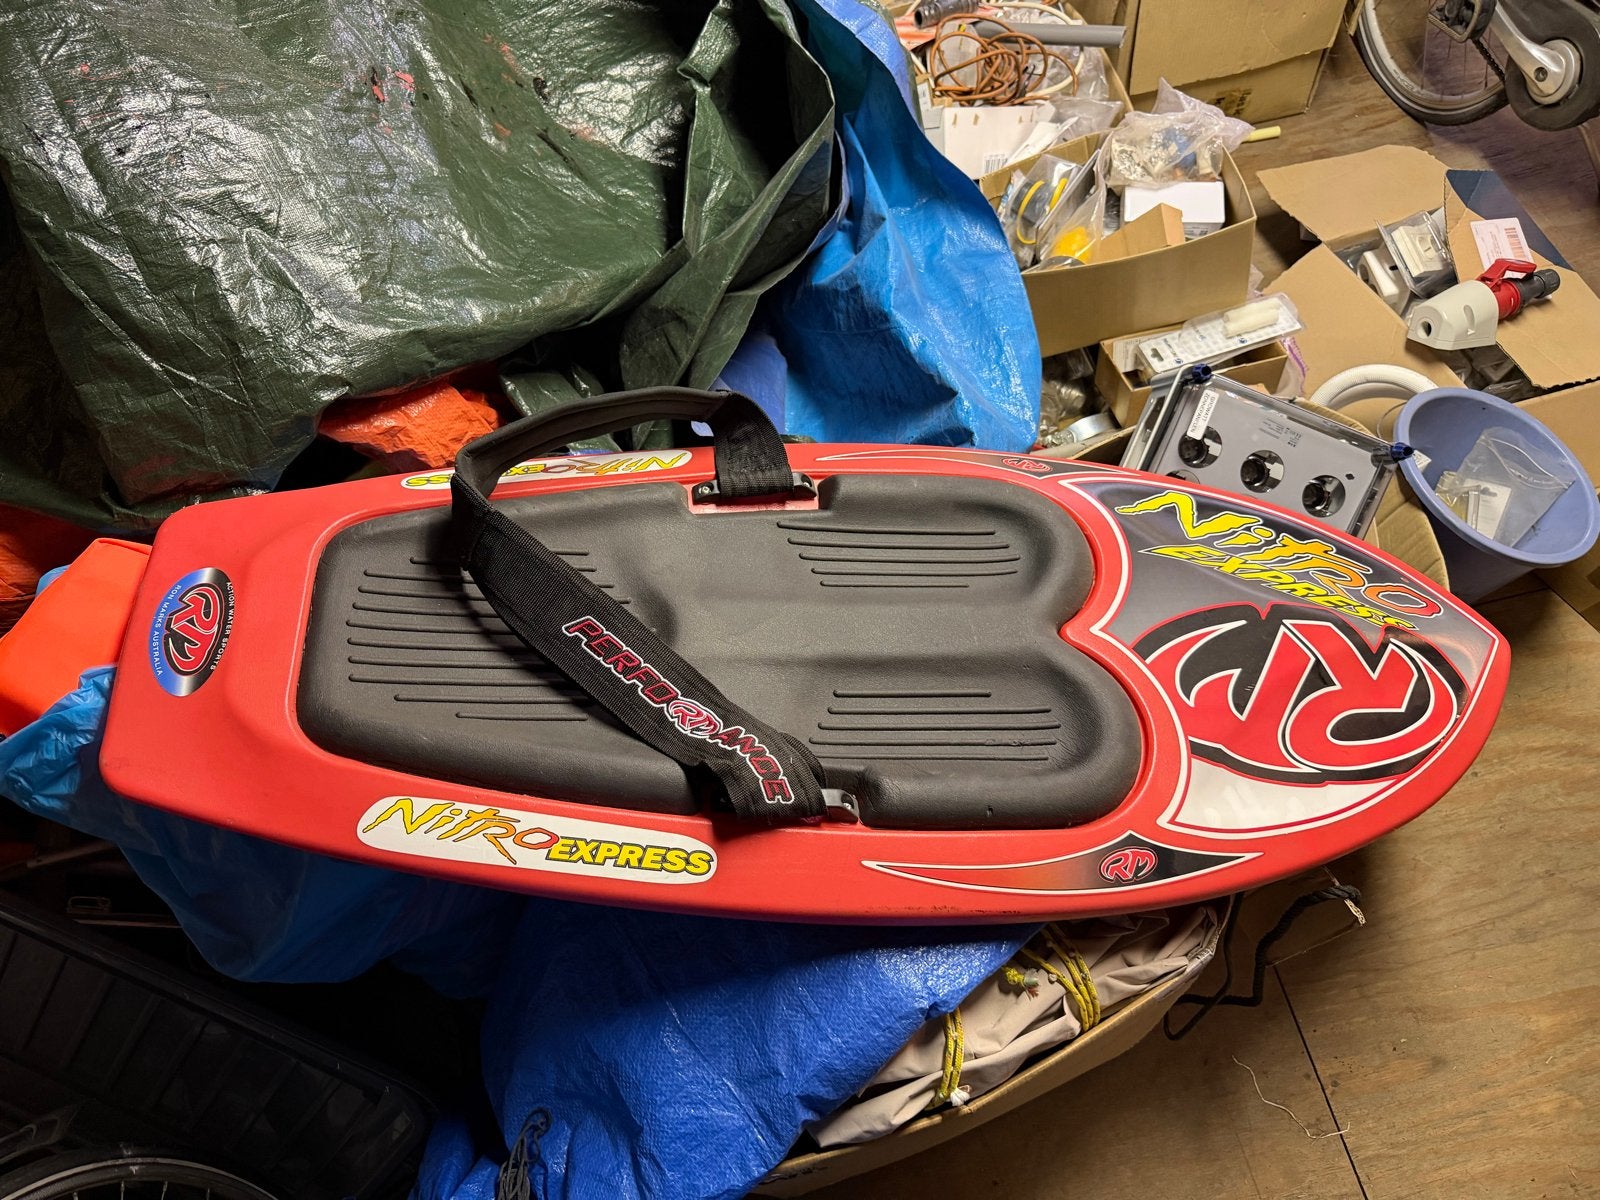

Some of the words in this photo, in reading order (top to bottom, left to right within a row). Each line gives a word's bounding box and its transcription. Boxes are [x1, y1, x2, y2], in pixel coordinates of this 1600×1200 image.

[1202, 396, 1216, 422] GROWATT
[167, 584, 182, 600] RON
[226, 581, 235, 607] ACTION
[1138, 545, 1420, 631] EXPRESS
[154, 601, 170, 628] MARKS
[224, 608, 235, 635] WATER
[152, 630, 164, 676] AUSTRALIA
[210, 637, 229, 671] SPORTS
[546, 835, 715, 876] EXPRESS
